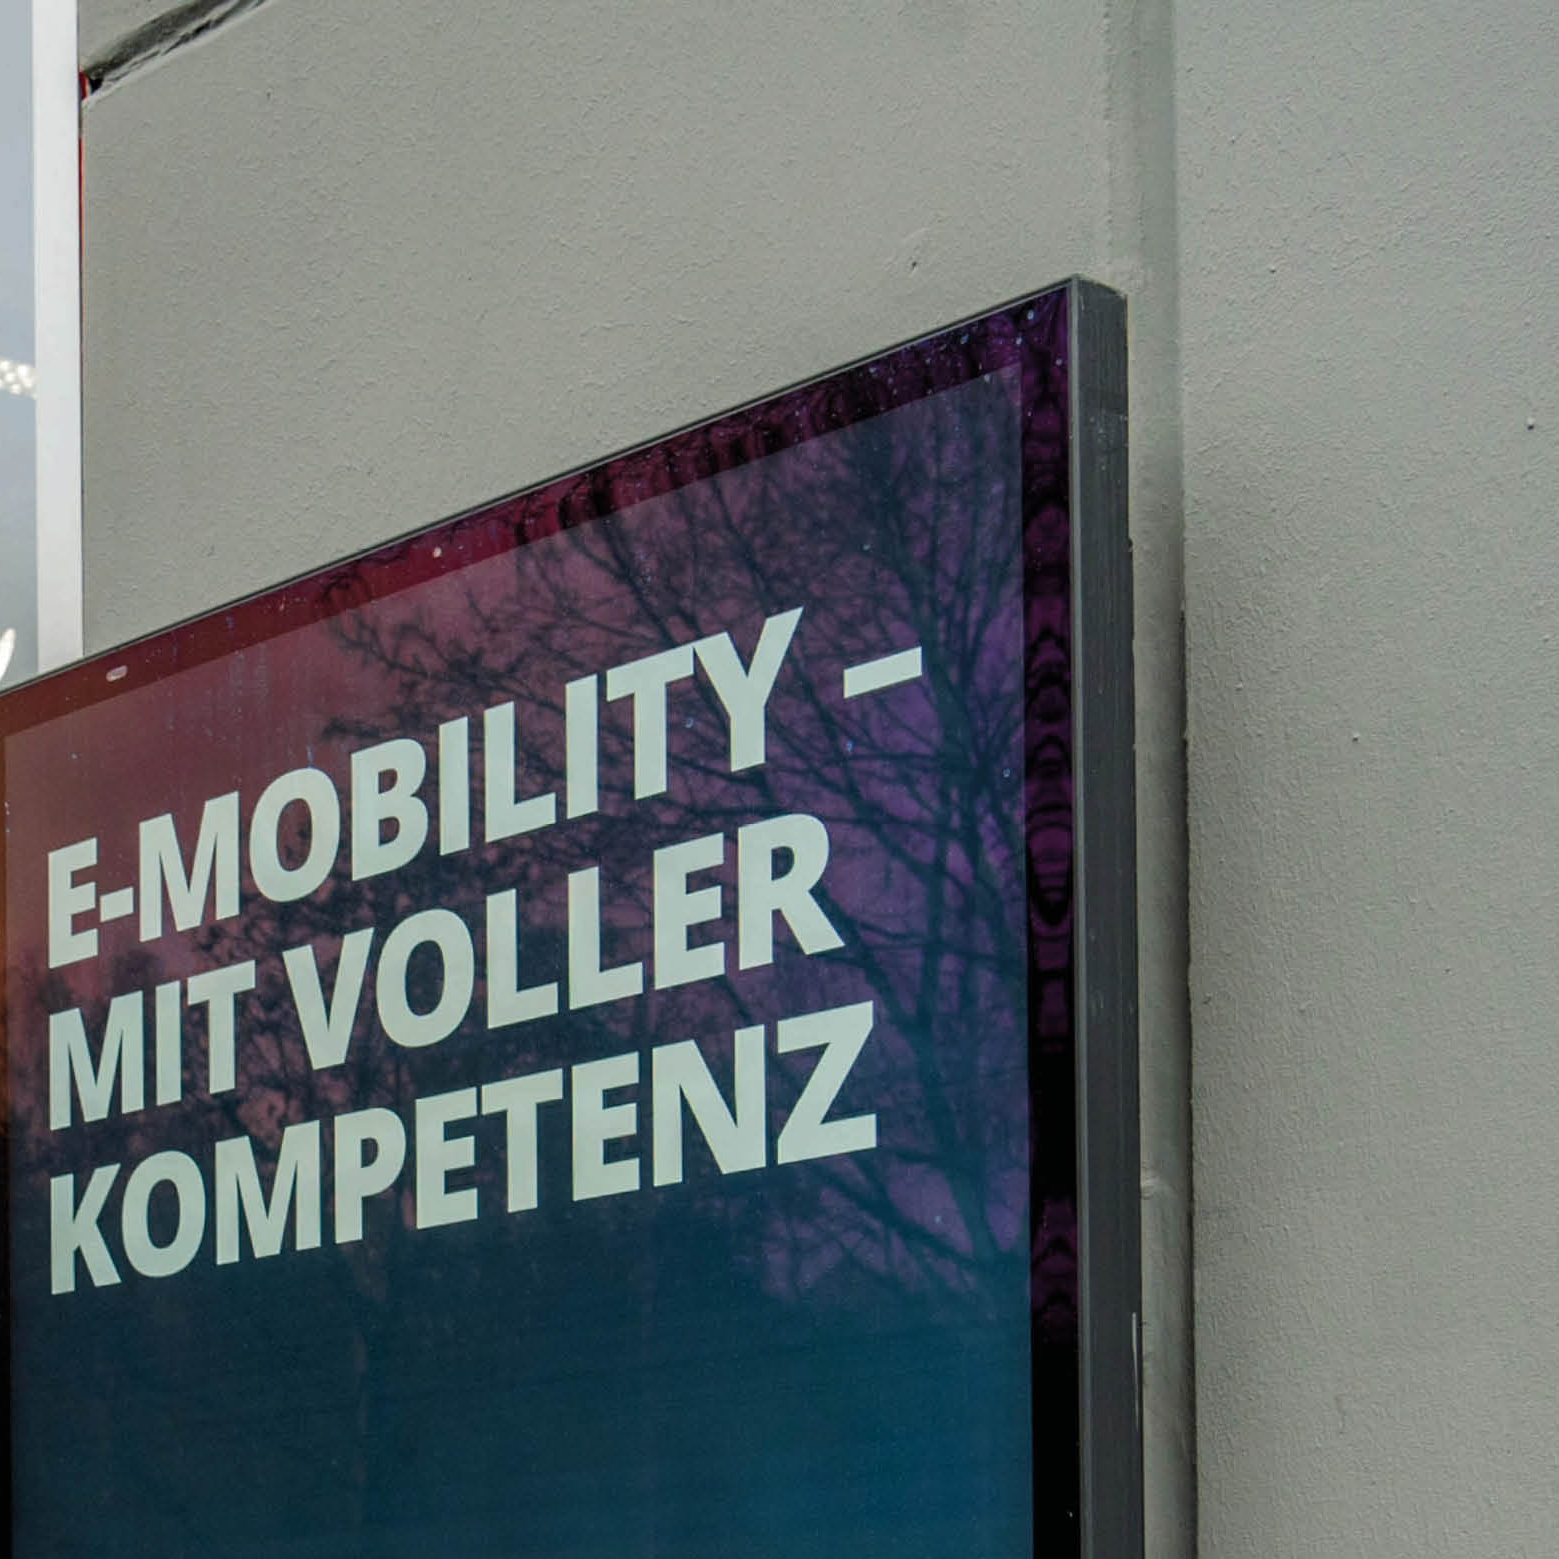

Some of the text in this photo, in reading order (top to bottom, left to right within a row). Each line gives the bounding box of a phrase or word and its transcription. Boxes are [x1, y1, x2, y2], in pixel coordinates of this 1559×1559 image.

[47, 606, 804, 969] E-MOBILITY
[48, 812, 845, 1131] MIT VOLLER
[49, 1000, 878, 1296] KOMPETENZ
